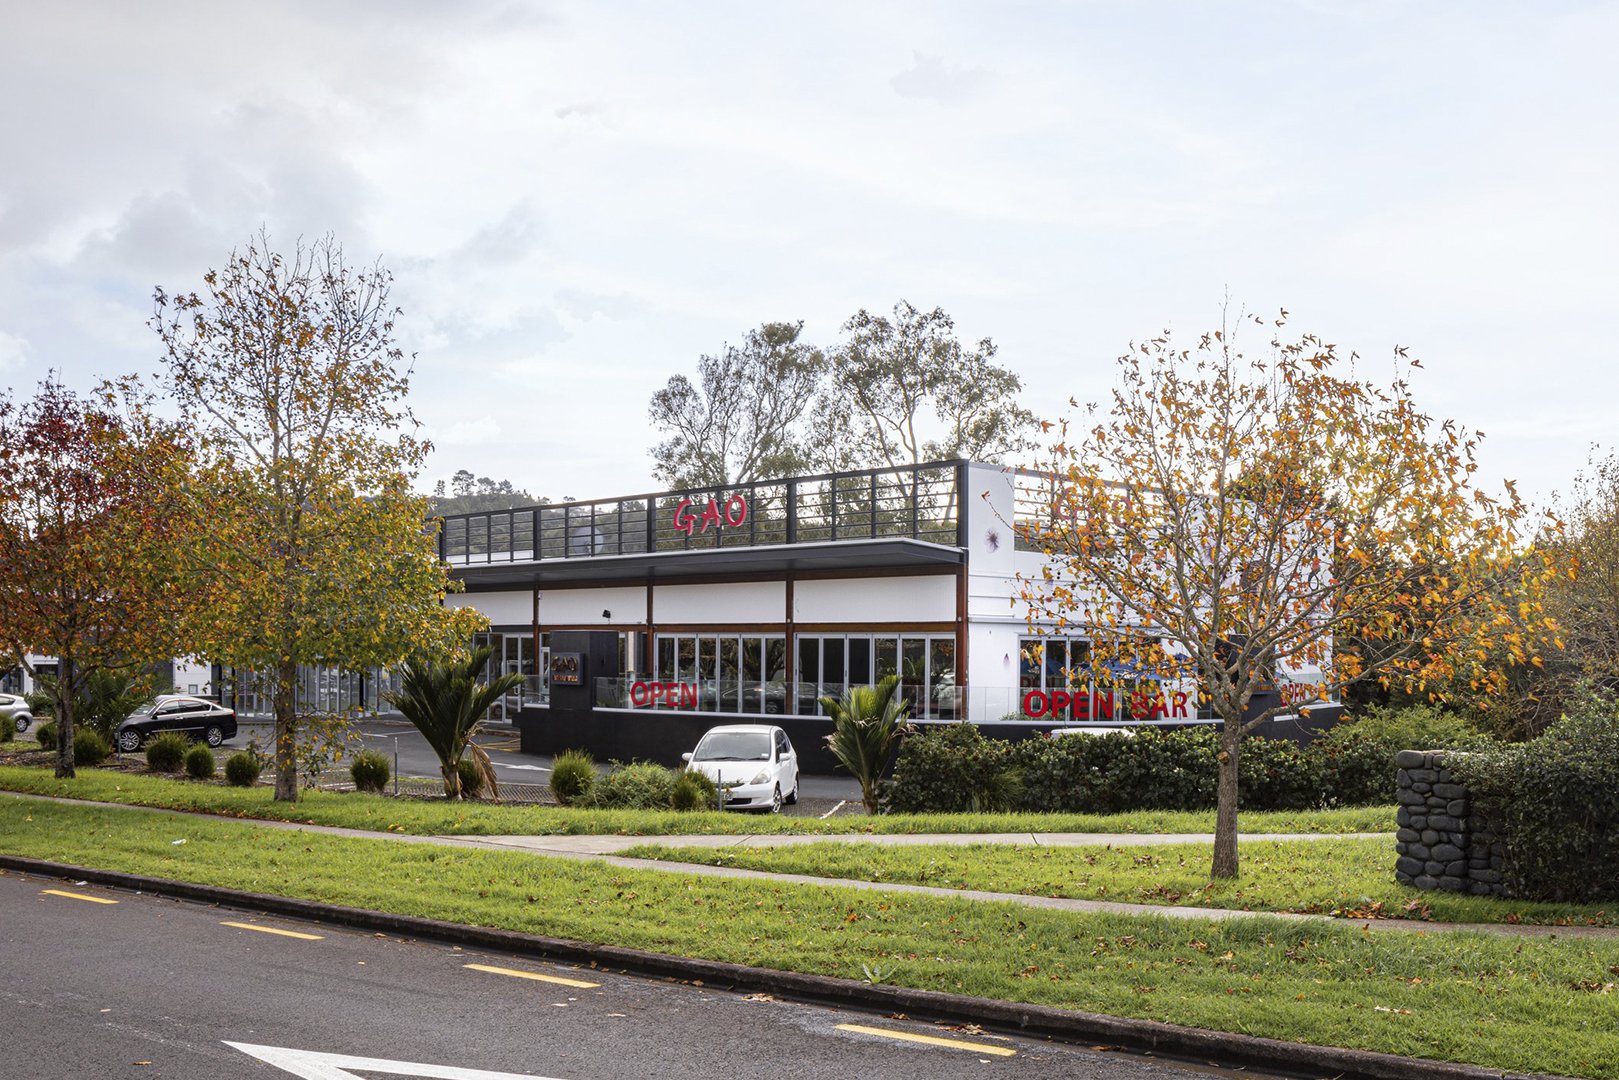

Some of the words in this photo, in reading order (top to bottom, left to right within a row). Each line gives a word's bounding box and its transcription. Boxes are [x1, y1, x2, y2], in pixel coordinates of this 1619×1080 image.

[673, 494, 747, 536] GAO
[630, 681, 698, 709] OPEN
[1023, 690, 1114, 719] OPEN
